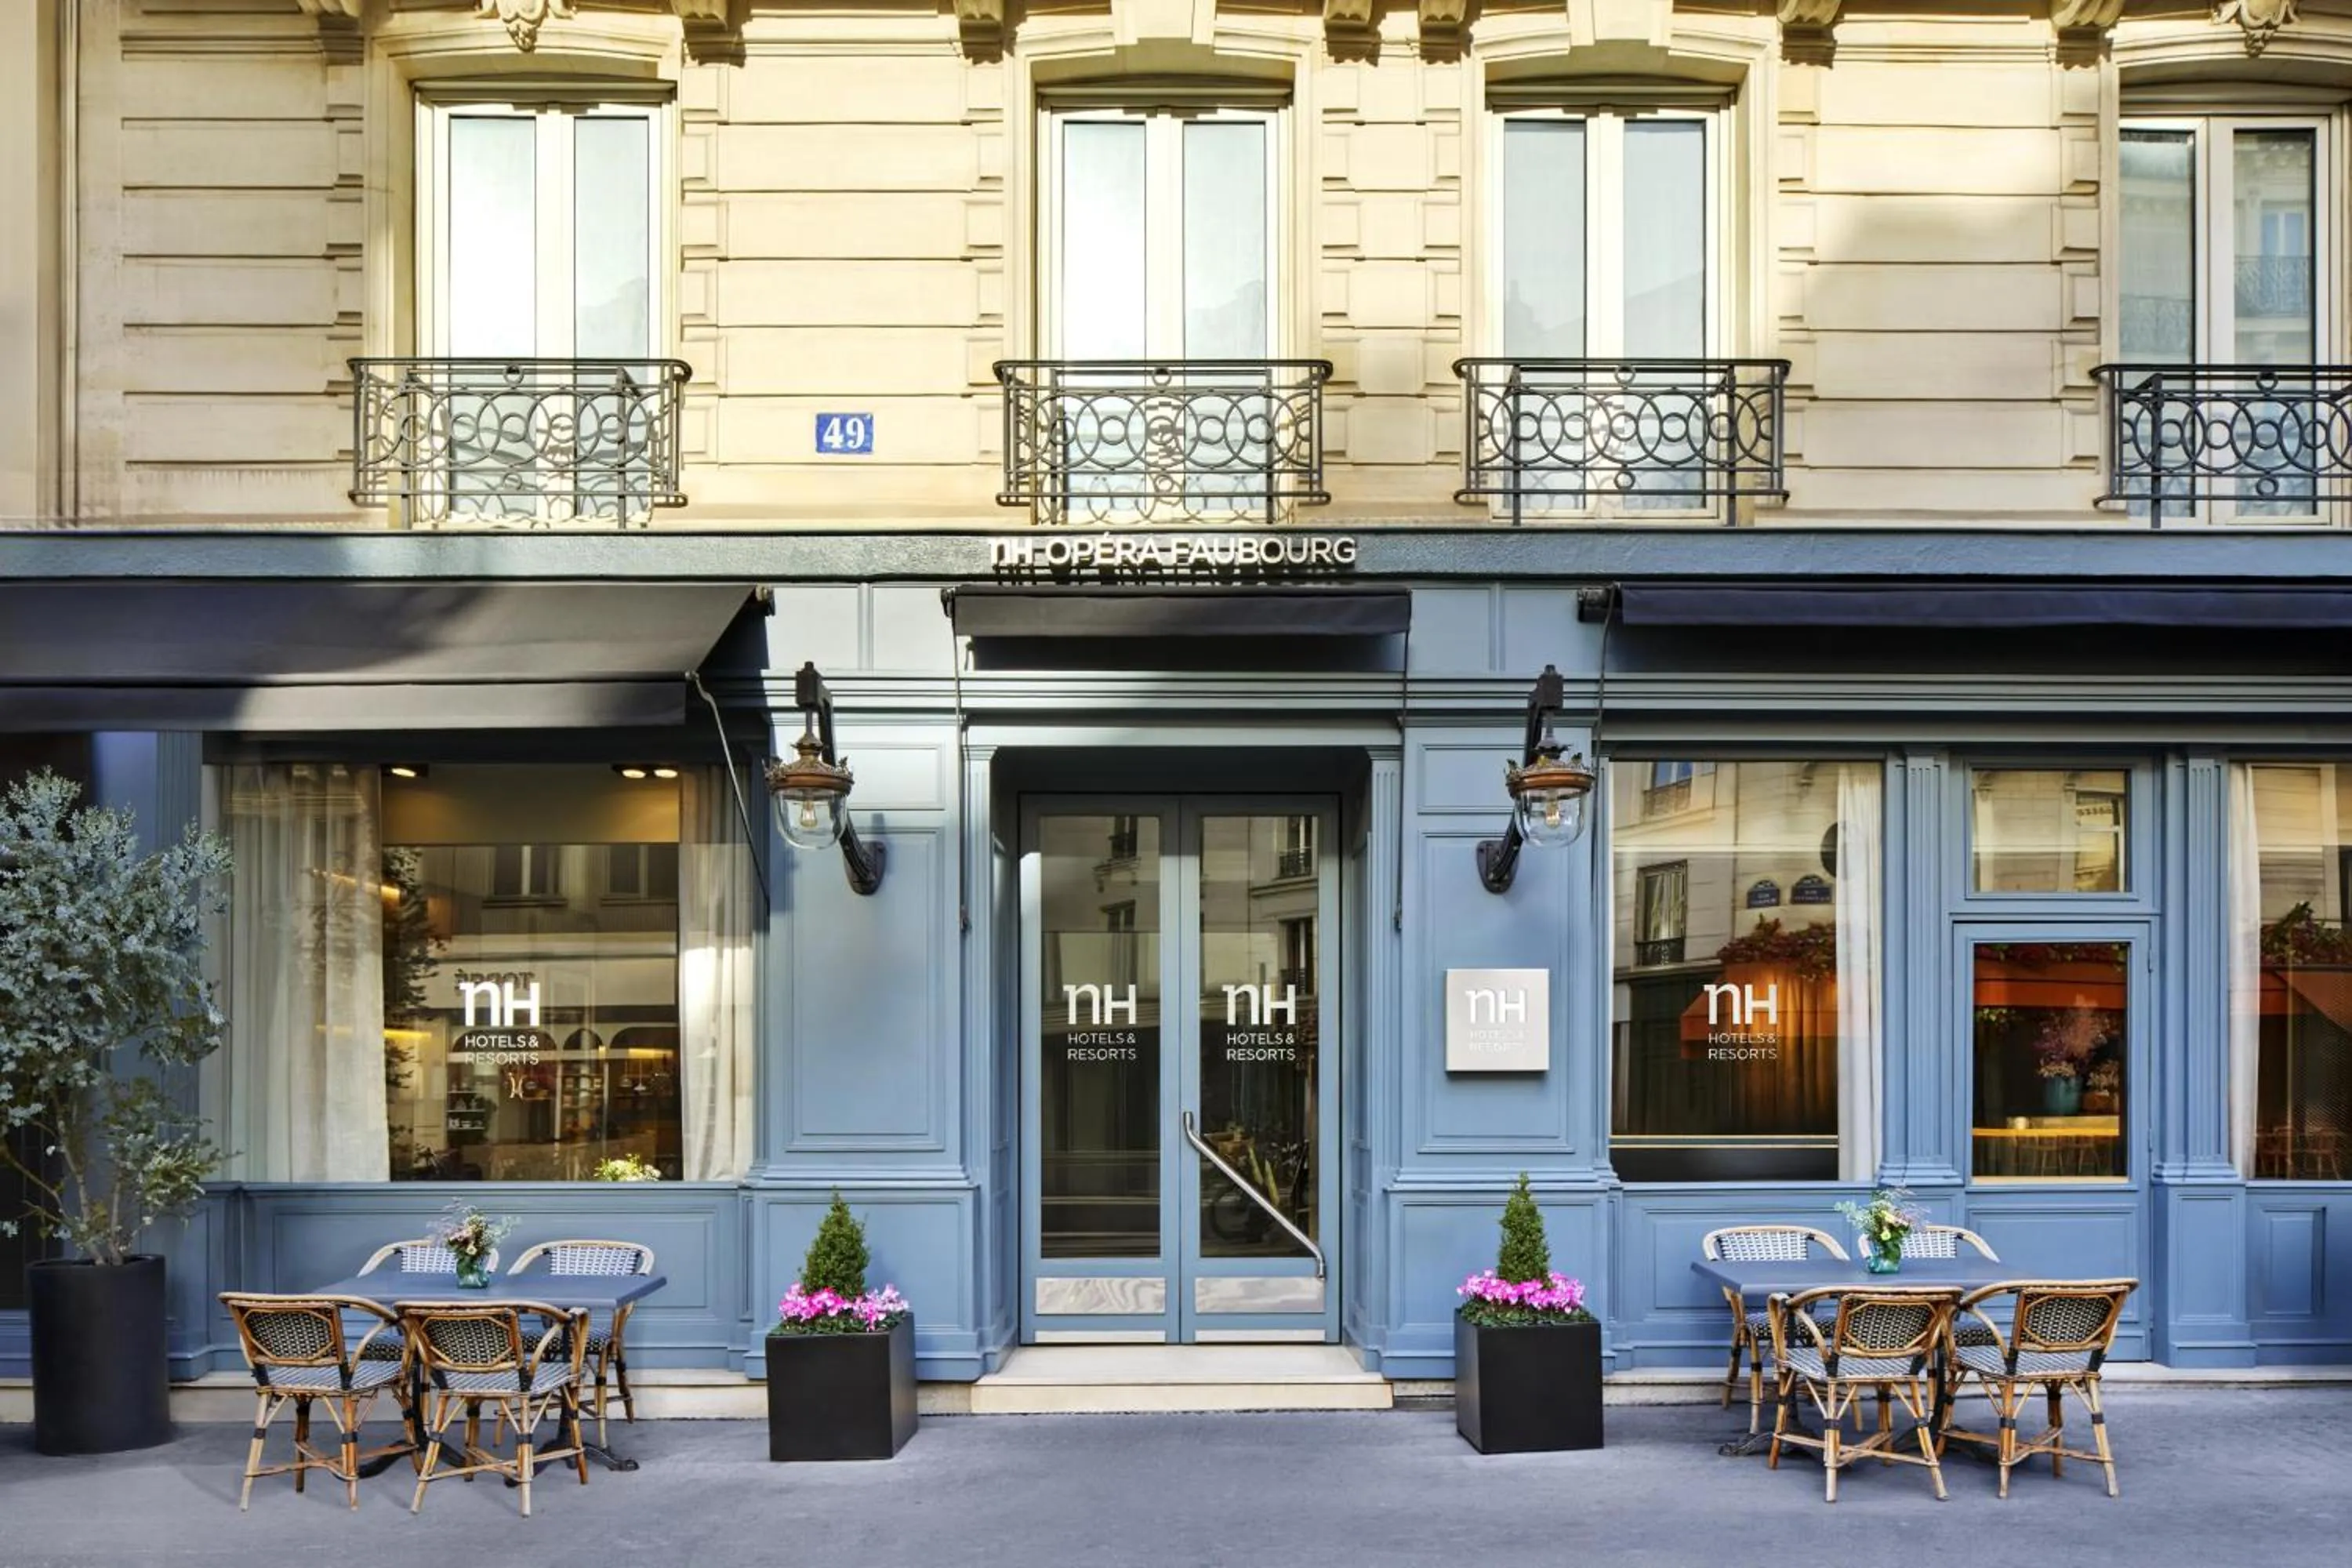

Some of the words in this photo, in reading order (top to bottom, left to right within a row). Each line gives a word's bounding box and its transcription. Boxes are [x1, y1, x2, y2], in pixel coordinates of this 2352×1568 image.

[822, 416, 866, 449] 49
[1045, 532, 1162, 565] OPÉRA
[1170, 537, 1356, 565] FAUBOURG
[464, 1034, 526, 1048] HOTELS
[1067, 1033, 1125, 1045] HOTELS
[1226, 1033, 1283, 1045] HOTELS
[1708, 1033, 1765, 1044] HOTELS
[465, 1051, 539, 1065] RESORTS
[1067, 1048, 1136, 1061] RESORTS
[1226, 1048, 1296, 1061] RESORTS
[1708, 1048, 1777, 1060] RESORTS
